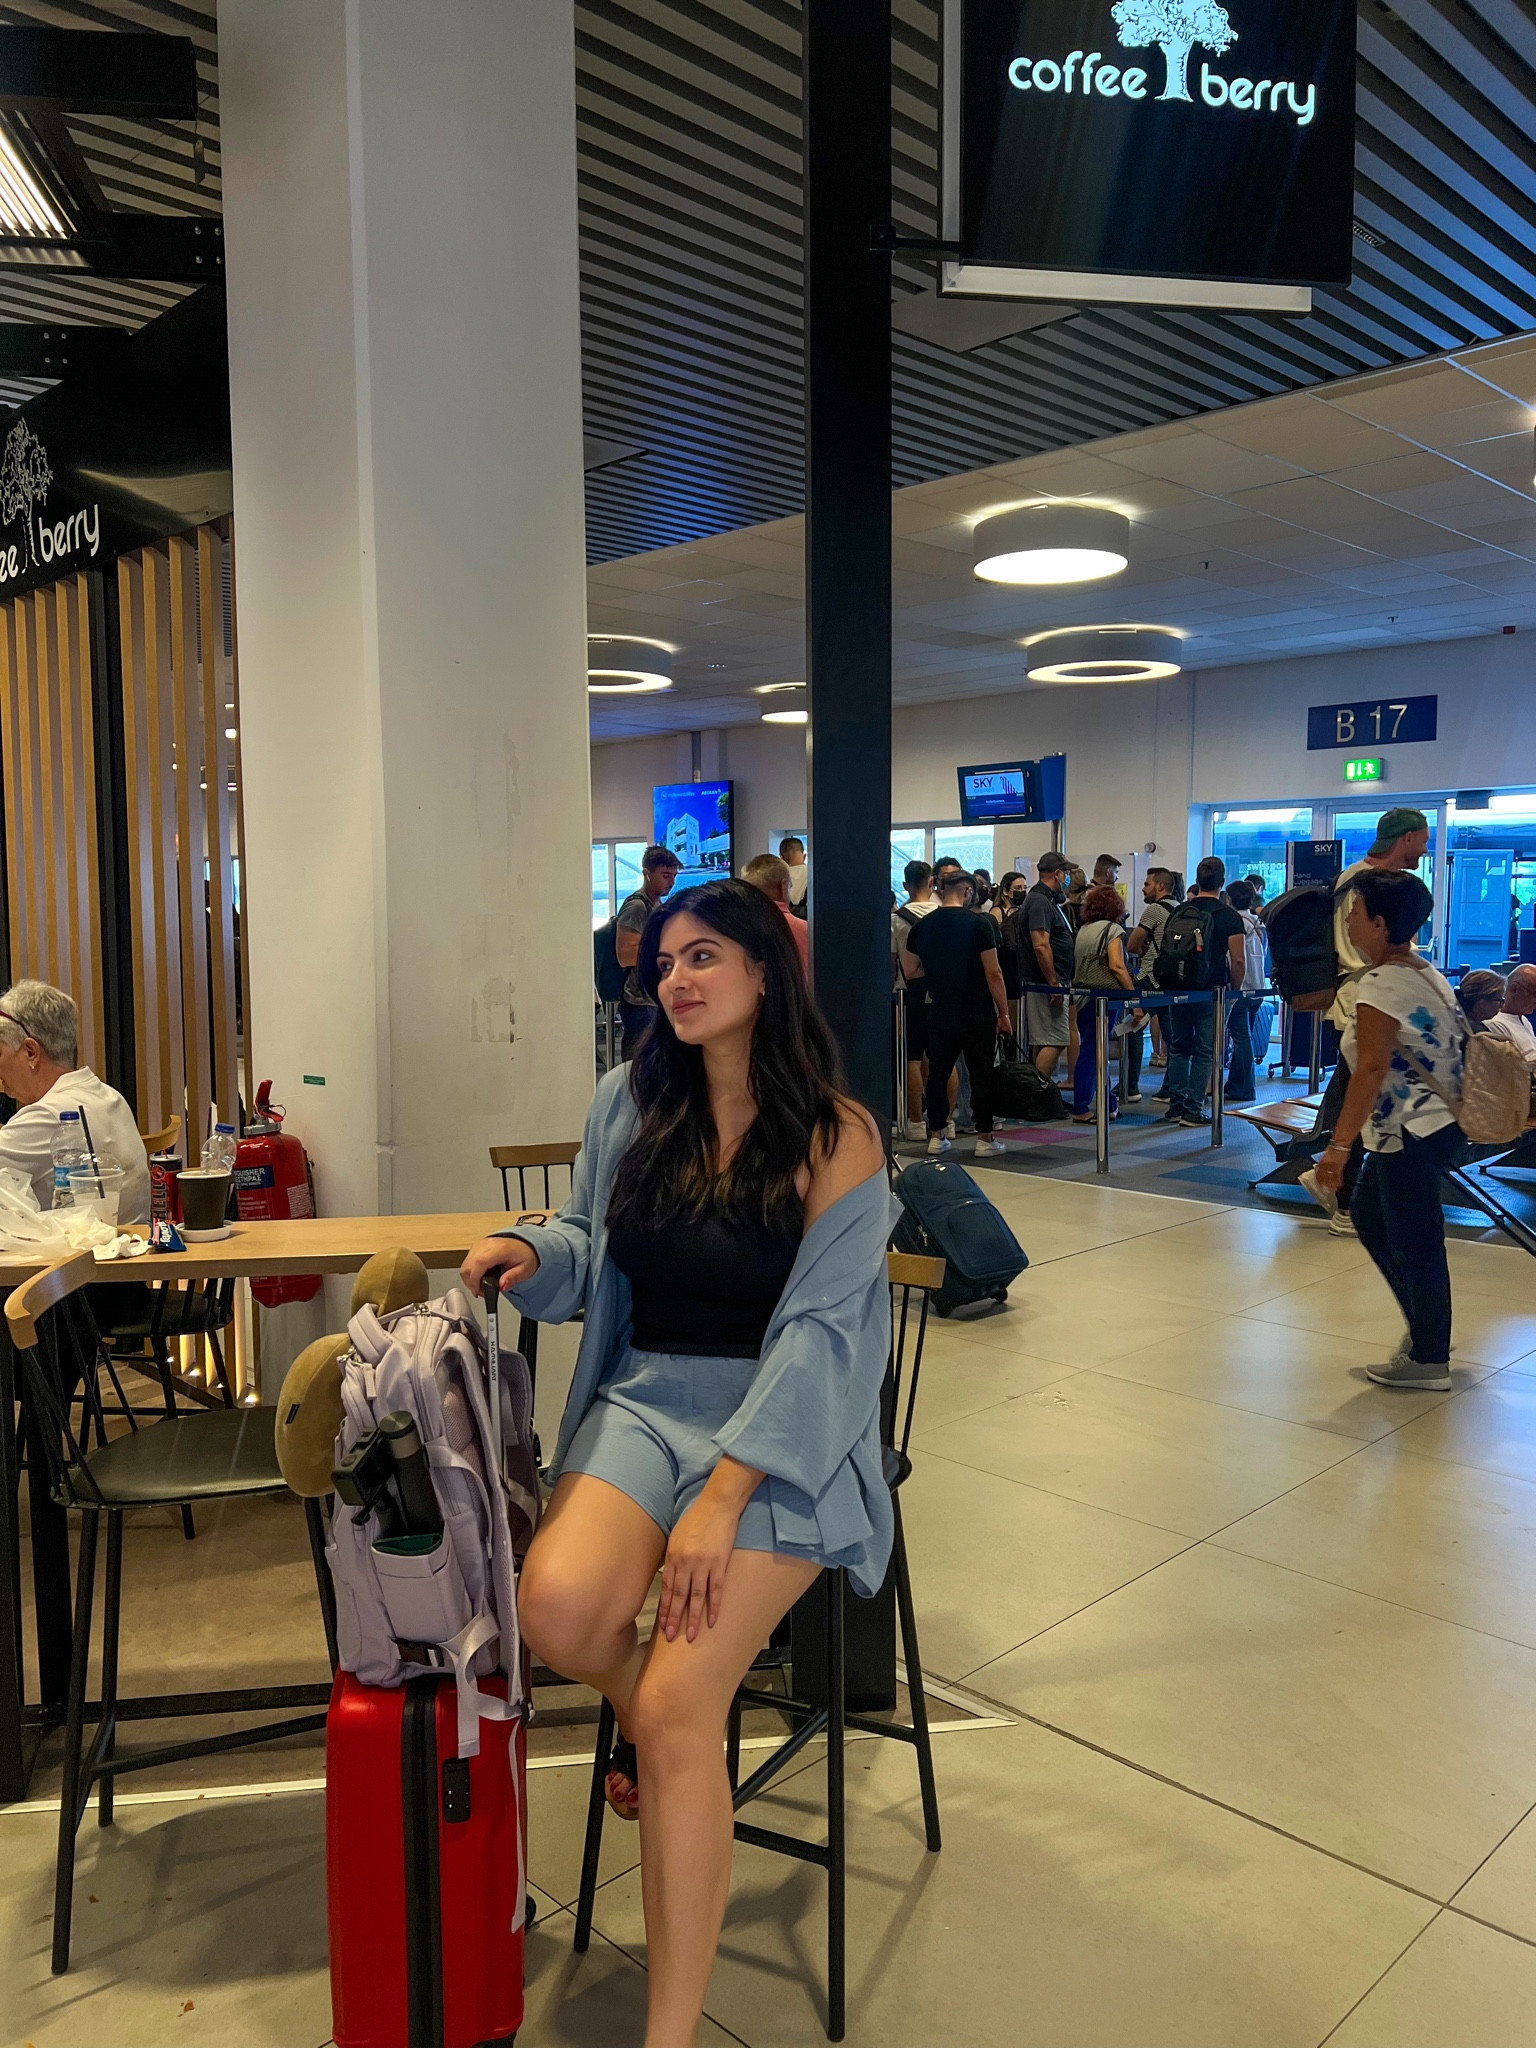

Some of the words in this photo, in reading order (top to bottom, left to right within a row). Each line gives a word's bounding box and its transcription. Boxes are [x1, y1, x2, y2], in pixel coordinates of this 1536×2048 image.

[1008, 50, 1148, 98] coffee
[1200, 63, 1316, 125] berry
[38, 503, 100, 563] berry
[1336, 709, 1356, 743] B
[1369, 704, 1408, 740] 17
[973, 777, 993, 788] SKY
[1247, 861, 1286, 872] swisspor
[1314, 844, 1332, 852] SKY
[152, 1182, 167, 1221] HELL
